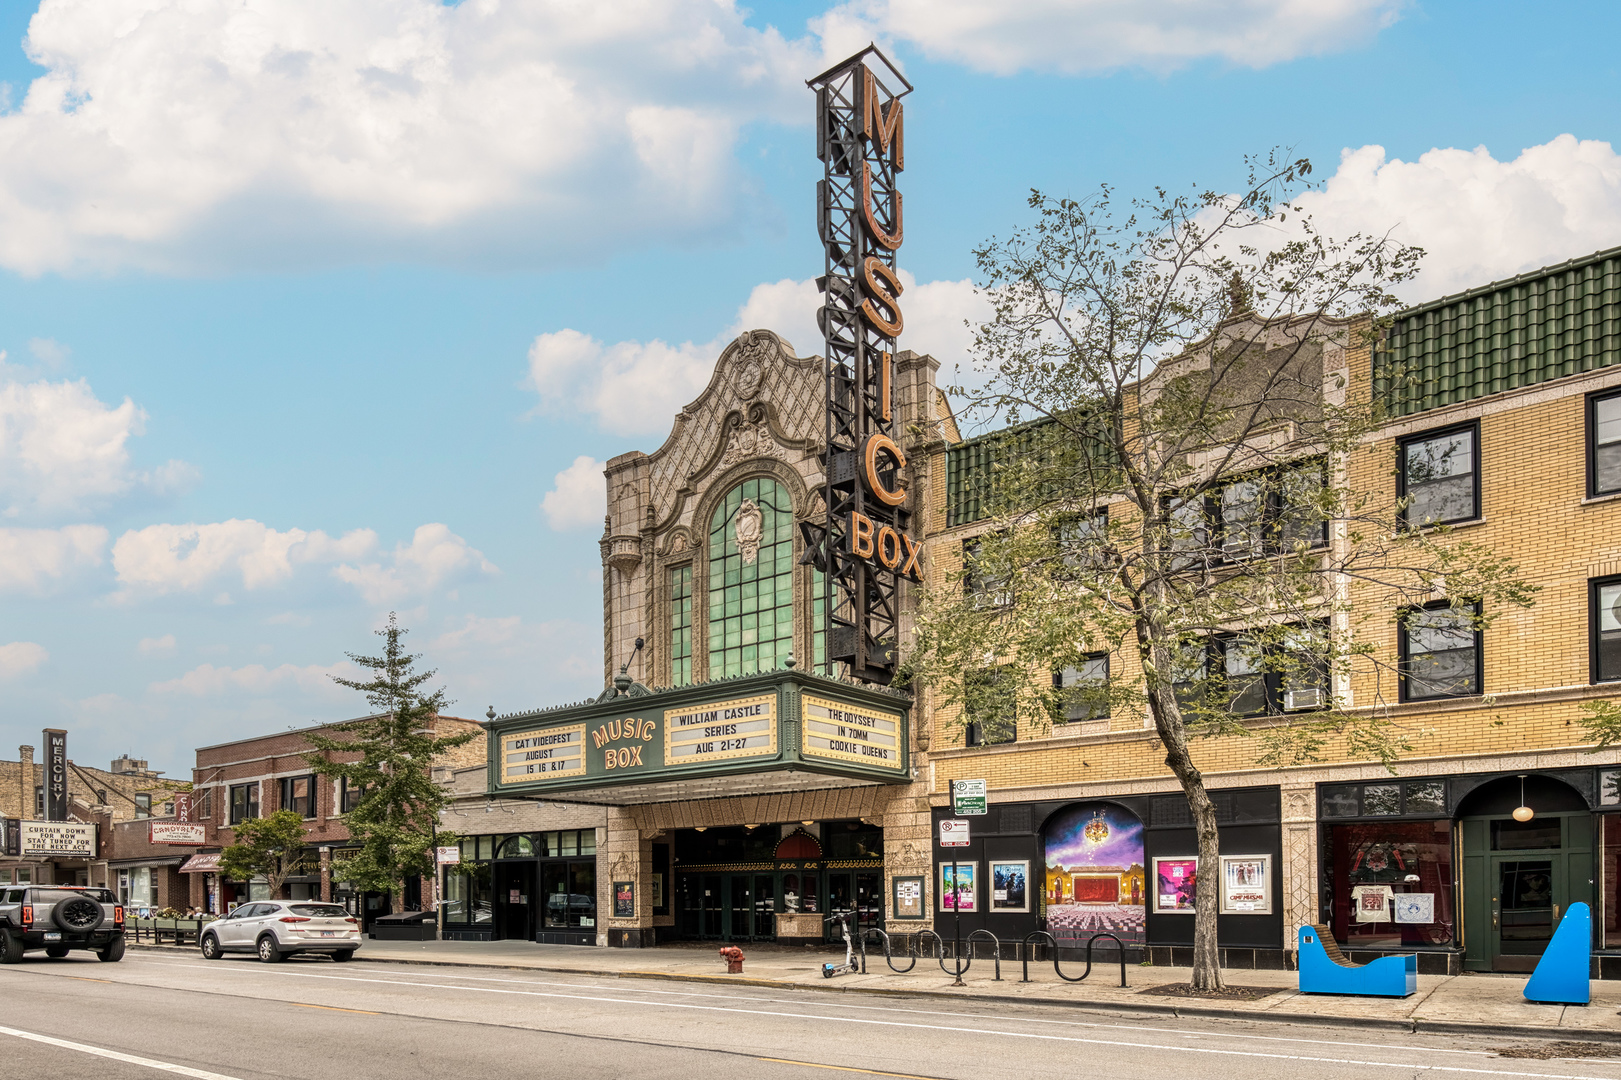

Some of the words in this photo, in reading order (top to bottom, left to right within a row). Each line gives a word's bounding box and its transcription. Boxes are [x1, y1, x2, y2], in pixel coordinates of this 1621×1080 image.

[860, 64, 907, 506] MUSIC
[850, 510, 925, 583] BOX
[679, 711, 718, 726] WILLIAM
[724, 704, 761, 720] CASTLE
[828, 708, 843, 722] THE
[844, 712, 876, 728] ODYSSEY
[592, 717, 656, 749] MUSIC
[704, 724, 737, 738] SERIES
[837, 726, 846, 737] IN
[848, 728, 868, 741] 70MM
[515, 738, 530, 749] CAT
[532, 733, 572, 747] VIDEOFEST
[695, 742, 714, 755] AUG
[720, 738, 747, 751] 21-27
[829, 740, 857, 754] COOKIE
[861, 745, 888, 759] QUEENS
[525, 749, 554, 761] AUGUST
[605, 745, 643, 770] BOX
[52, 737, 63, 801] MERCURY
[526, 763, 534, 774] 15
[538, 761, 547, 773] 16
